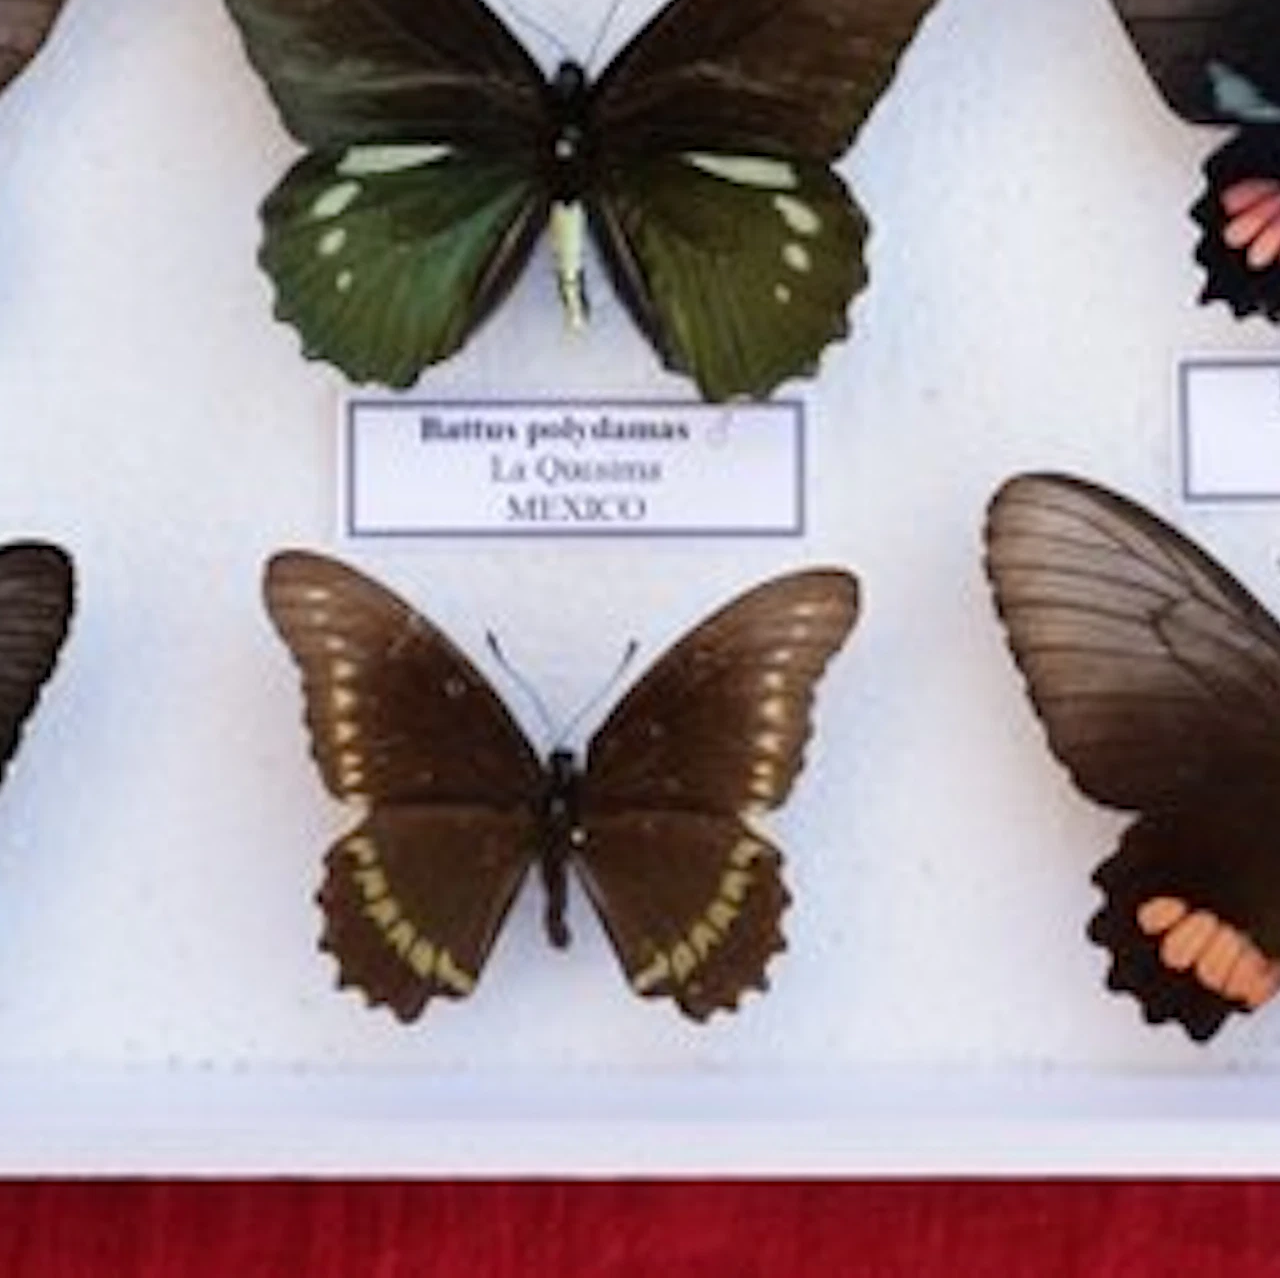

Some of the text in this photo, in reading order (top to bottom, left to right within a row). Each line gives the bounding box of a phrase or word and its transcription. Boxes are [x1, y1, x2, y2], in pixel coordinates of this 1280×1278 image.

[421, 416, 690, 448] Battus polydamas
[491, 455, 526, 483] La
[506, 495, 647, 522] MEXICO
